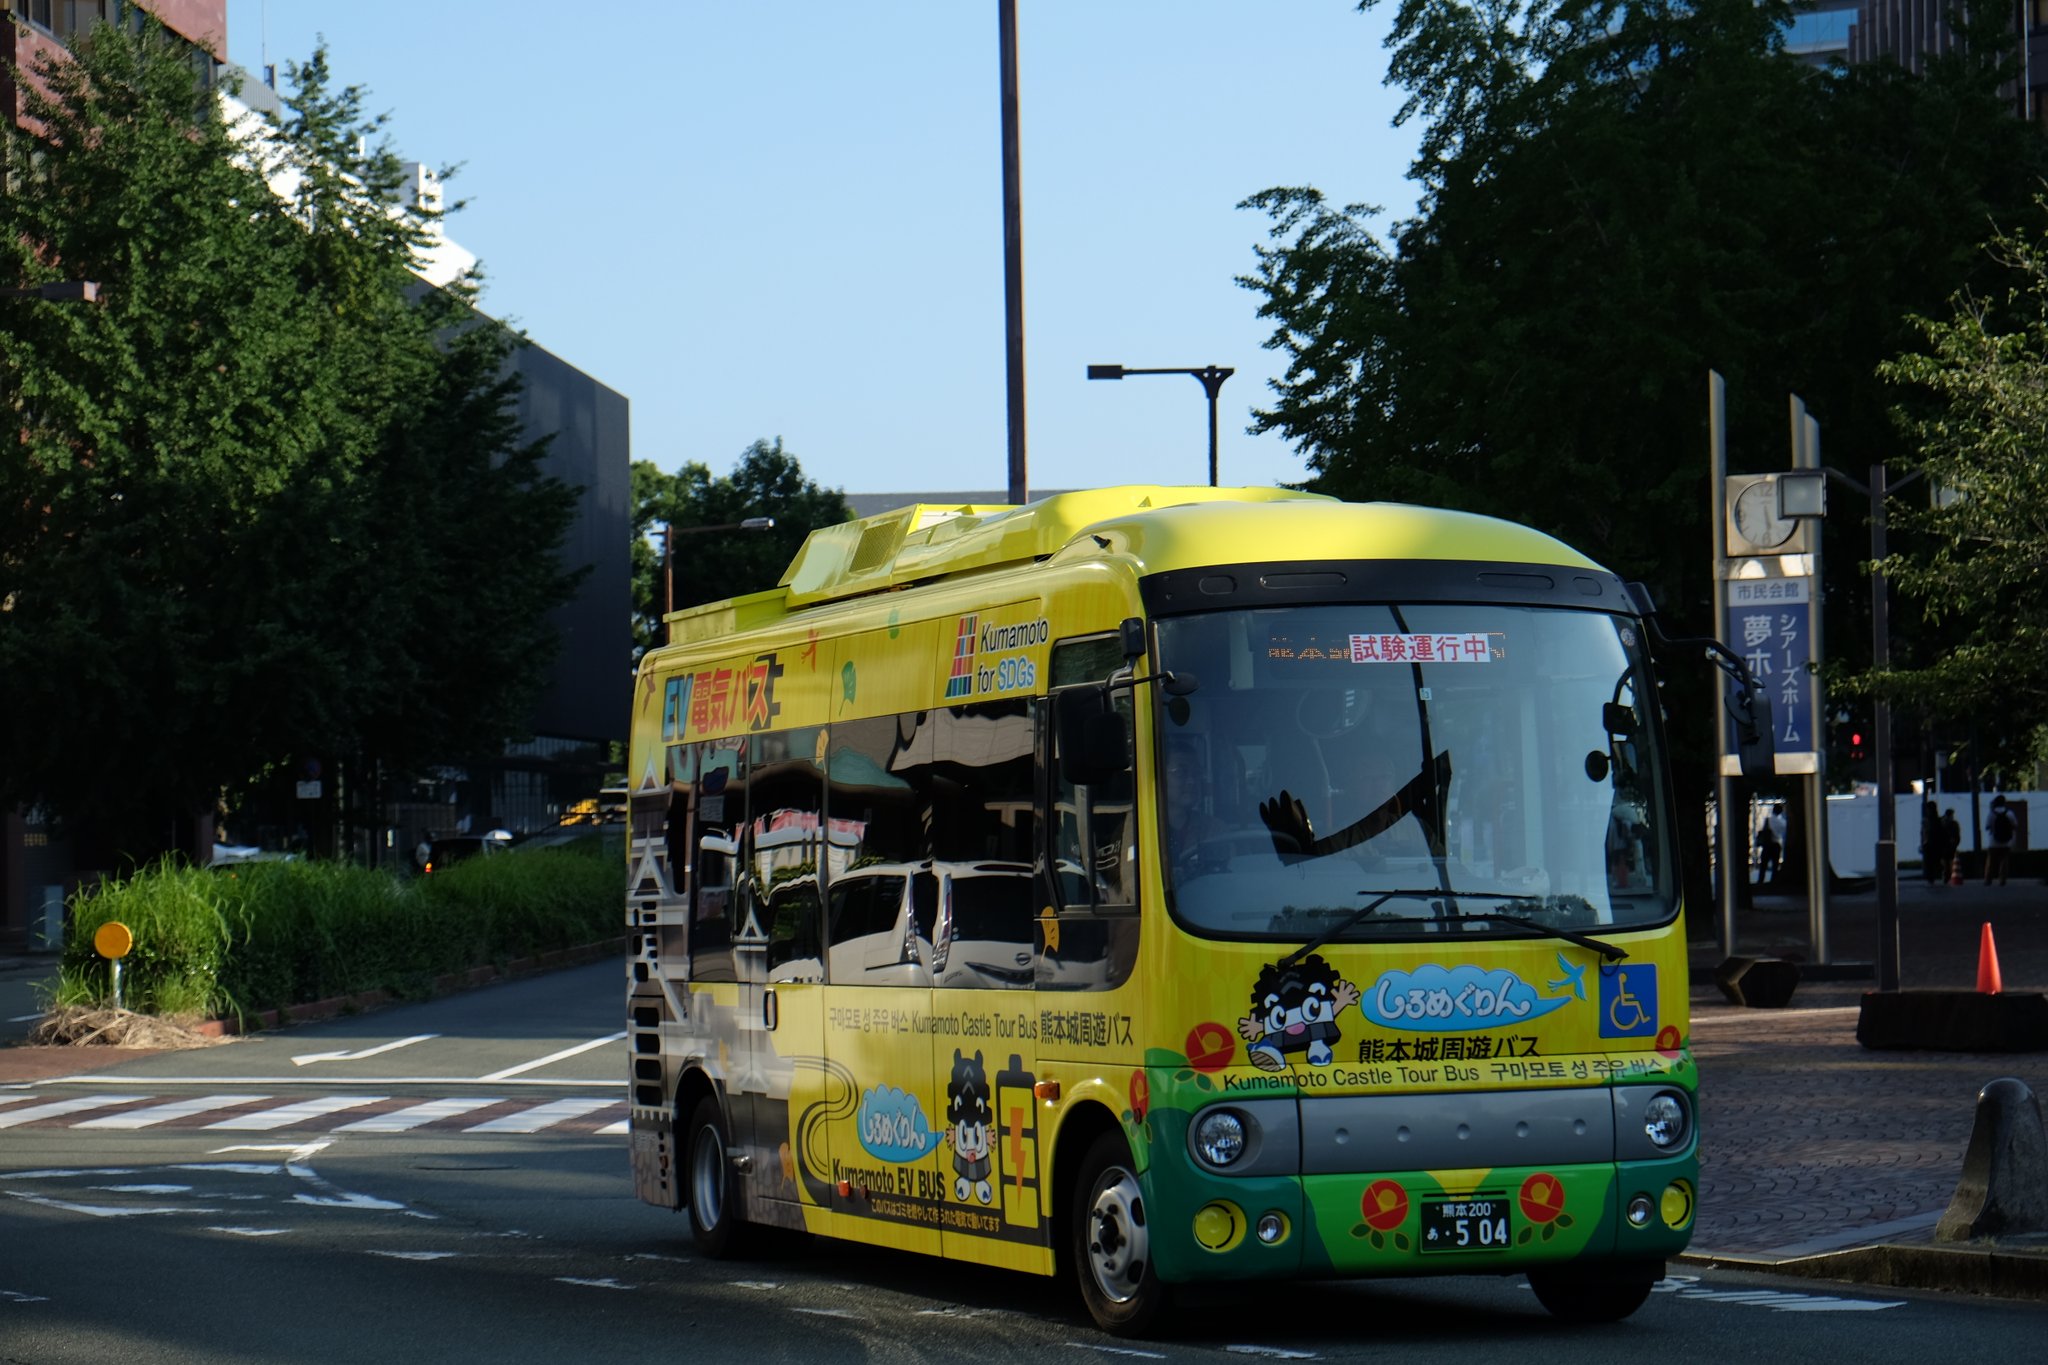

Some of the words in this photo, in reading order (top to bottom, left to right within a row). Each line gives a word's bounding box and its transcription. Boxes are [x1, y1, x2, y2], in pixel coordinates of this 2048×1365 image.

[1737, 581, 1799, 600] 市民会館
[979, 619, 1049, 654] Kumamoto
[1351, 635, 1486, 662] 試験運行中
[977, 664, 995, 694] for
[996, 657, 1036, 692] SDGs
[1779, 613, 1801, 743] シアーズホーム
[1376, 977, 1531, 1020] しろめぐりん
[912, 1010, 959, 1036] Kumamoto
[961, 1011, 991, 1038] Castle
[993, 1013, 1016, 1039] Tour
[1018, 1013, 1037, 1040] Bus
[1040, 1010, 1134, 1047] 熊本城周遊バス
[1359, 1035, 1541, 1063] 熊本城周遊バス
[1224, 1068, 1327, 1090] Kumamoto
[1333, 1066, 1392, 1085] Castle
[1399, 1066, 1439, 1083] Tour
[1446, 1065, 1479, 1082] Bus
[1491, 1062, 1566, 1081] 구마모토
[1571, 1060, 1588, 1079] 성
[1593, 1059, 1627, 1079] 주유
[1630, 1058, 1665, 1077] 버스
[863, 1100, 925, 1150] しろめぐりん
[833, 1158, 894, 1194] Kumamoto
[898, 1166, 914, 1195] EV
[919, 1169, 946, 1201] BUS
[1426, 1226, 1439, 1241] あ
